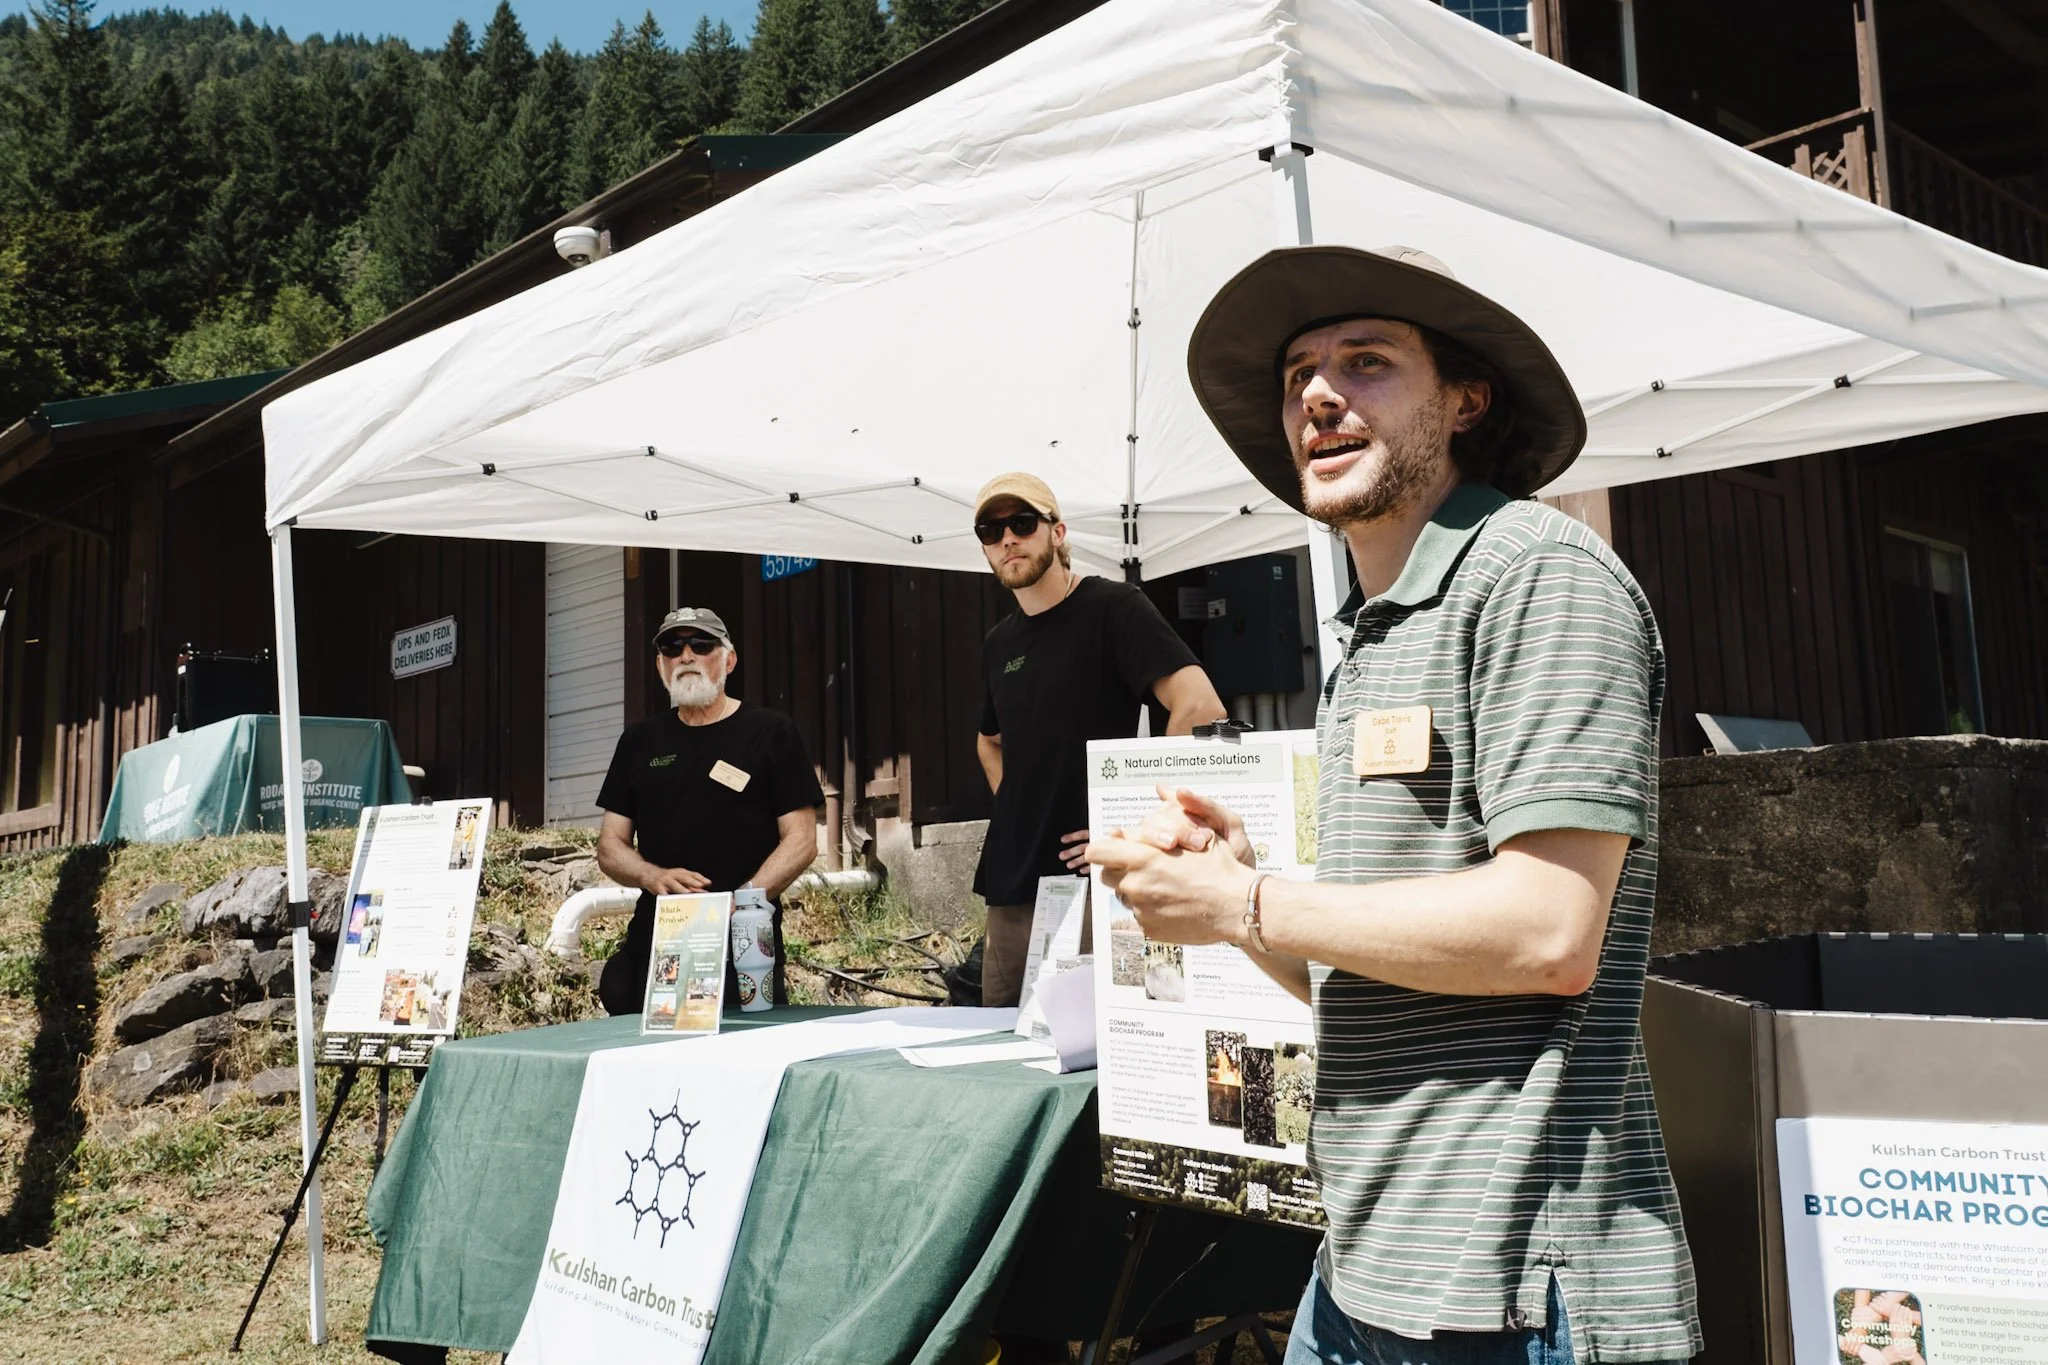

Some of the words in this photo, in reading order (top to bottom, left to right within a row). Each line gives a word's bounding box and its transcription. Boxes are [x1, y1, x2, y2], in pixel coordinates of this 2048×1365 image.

[397, 636, 412, 651] UPS
[414, 631, 430, 647] AND
[433, 624, 451, 641] FEDX
[394, 647, 434, 669] DELIVERIES
[435, 642, 453, 659] HERE
[1125, 757, 1163, 768] Natural
[1165, 755, 1207, 767] Climate
[1209, 753, 1261, 765] Solutions
[303, 783, 362, 799] INSTITUTE
[1109, 1019, 1144, 1028] COMMUNITY
[1109, 1026, 1134, 1035] BIOCHAR
[1135, 1029, 1165, 1038] PROGRAM
[1872, 1144, 1936, 1157] Kulshan
[1940, 1146, 1999, 1159] Carbon
[2002, 1149, 2047, 1161] Trust
[1859, 1167, 2048, 1197] COMMUNITY
[1804, 1194, 1953, 1223] BIOCHAR
[1864, 1235, 1883, 1245] has
[1886, 1237, 1936, 1248] partnered
[1939, 1241, 1960, 1249] with
[1963, 1242, 1980, 1250] the
[1982, 1243, 2035, 1253] Whatcom
[1834, 1246, 1901, 1257] Conservation
[1903, 1249, 1944, 1260] Districts
[1947, 1252, 1958, 1261] to
[1960, 1253, 1983, 1262] host
[1994, 1256, 2026, 1265] series
[2028, 1257, 2039, 1266] of
[1843, 1258, 1897, 1269] workshops
[1899, 1260, 1920, 1270] that
[1923, 1262, 1990, 1274] demonstrate
[1993, 1267, 2034, 1277] biochar
[1881, 1272, 1909, 1282] using
[549, 1247, 617, 1294] Kulshan
[621, 1275, 677, 1317] Carbon
[681, 1296, 715, 1331] Trust
[1936, 1303, 1970, 1313] Involve
[1971, 1305, 1990, 1314] and
[1992, 1306, 2015, 1315] train
[1841, 1318, 1917, 1336] Community
[1938, 1315, 1964, 1324] make
[1966, 1317, 1987, 1326] their
[1990, 1319, 2010, 1327] own
[1845, 1332, 1918, 1348] Workshops
[1940, 1327, 1960, 1336] Sets
[1961, 1328, 1977, 1337] the
[1978, 1330, 2006, 1341] stage
[2008, 1331, 2021, 1340] for
[2023, 1334, 2031, 1342] a
[1941, 1340, 1957, 1349] kiln
[1958, 1341, 1980, 1350] loan
[1981, 1343, 2024, 1354] program
[1942, 1352, 1978, 1363] Engage
